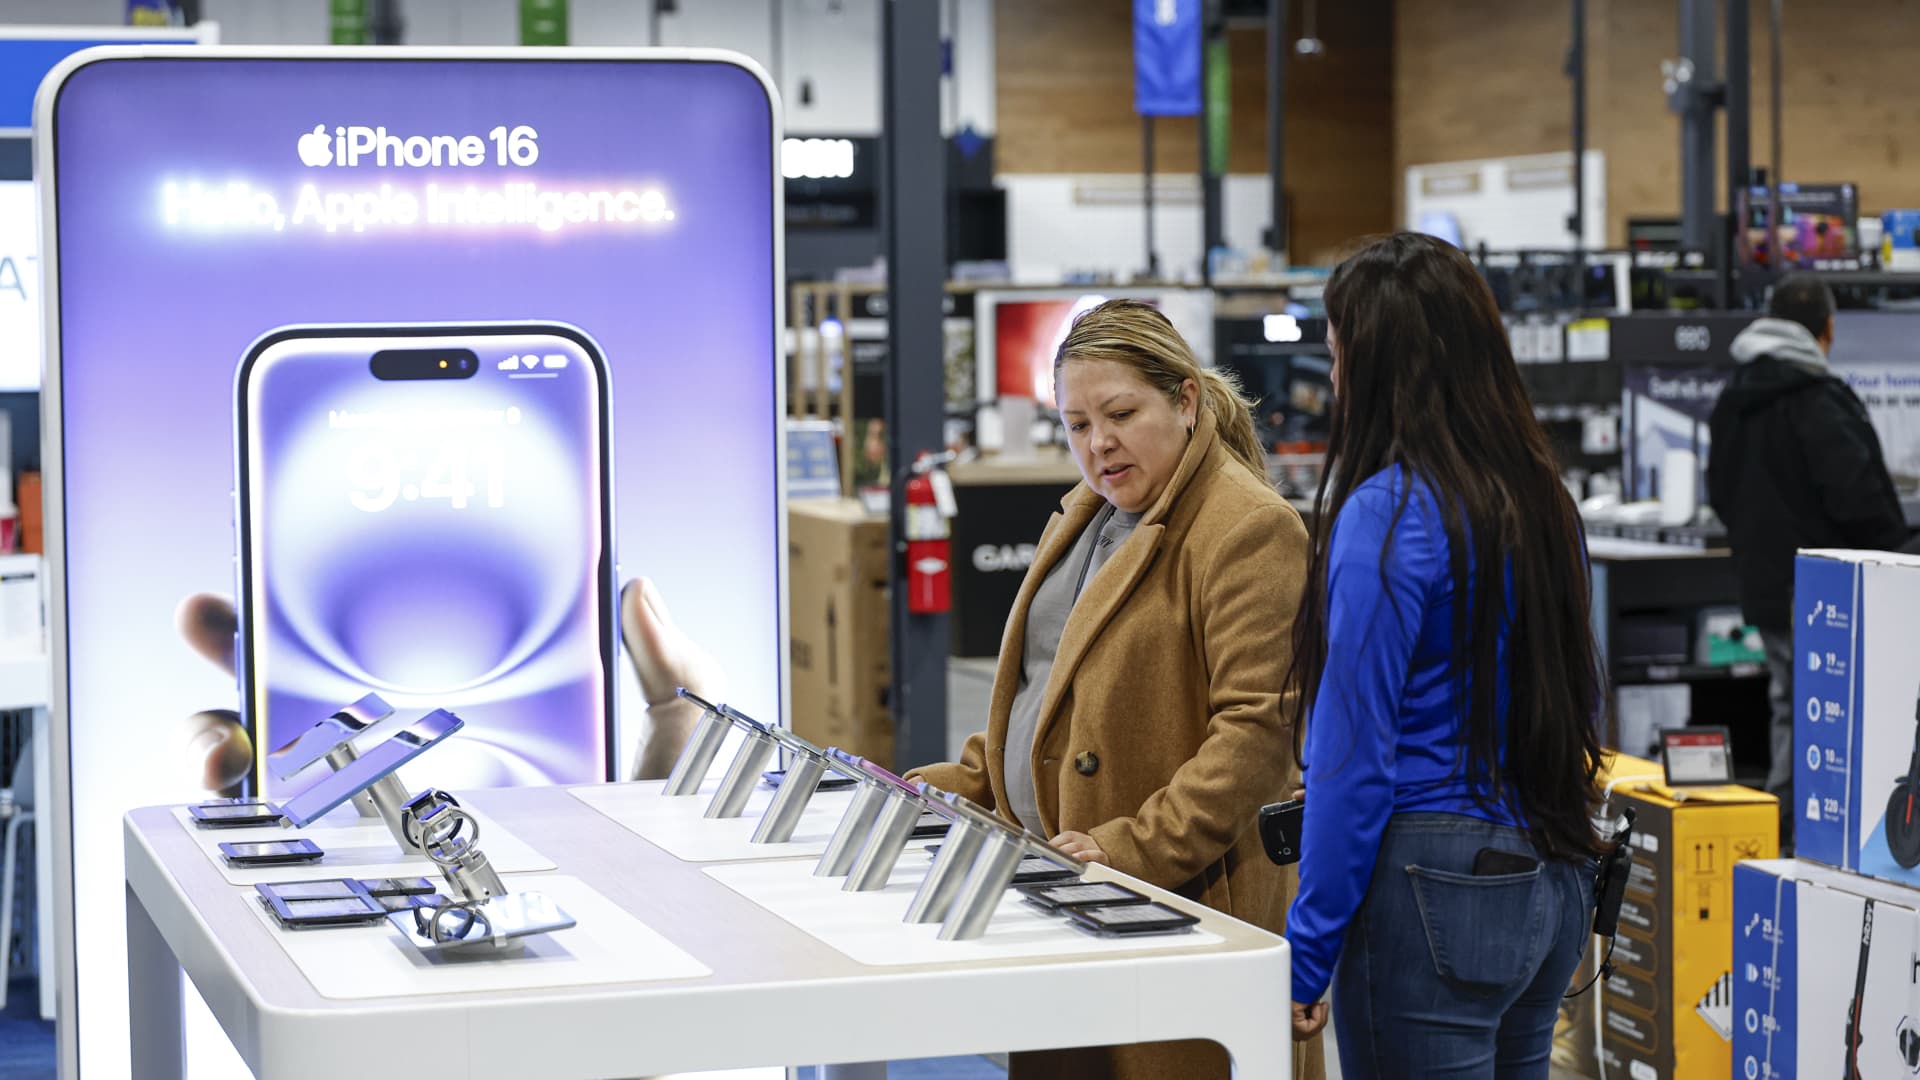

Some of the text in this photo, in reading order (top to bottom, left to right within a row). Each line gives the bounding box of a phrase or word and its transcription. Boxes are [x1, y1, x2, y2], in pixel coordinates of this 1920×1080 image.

[335, 124, 540, 168] iPhone 16
[164, 181, 675, 233] Hello, Apple Intelligence.
[345, 440, 506, 513] 9:41
